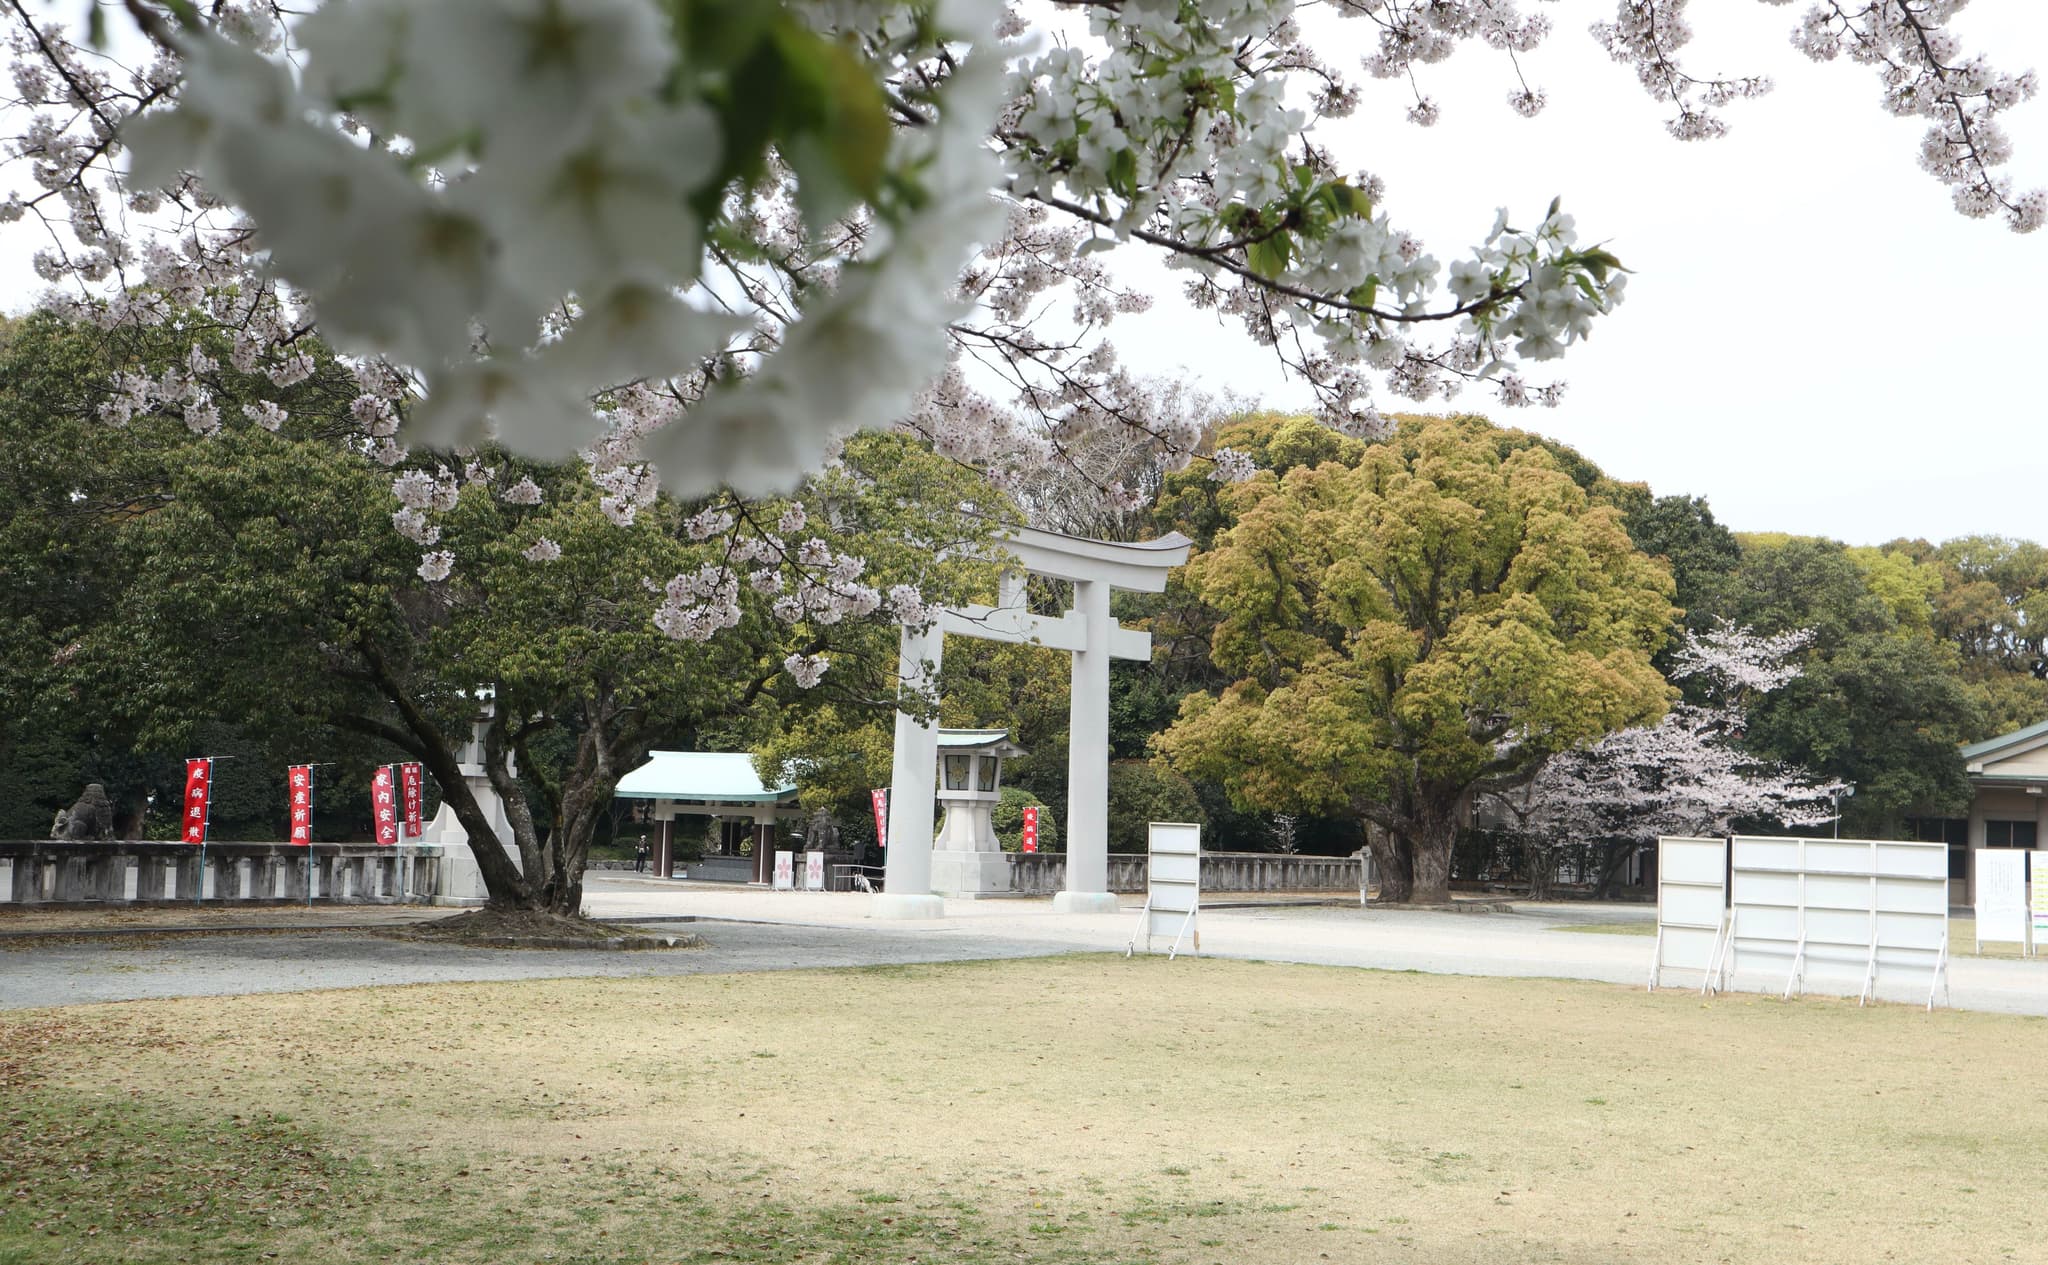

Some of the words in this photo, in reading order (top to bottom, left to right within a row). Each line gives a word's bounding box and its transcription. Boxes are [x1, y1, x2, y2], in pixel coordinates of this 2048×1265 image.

[189, 768, 205, 838] 疫病退散
[293, 774, 307, 838] 安産祈願
[376, 773, 394, 839] 家内安全
[1025, 813, 1034, 853] 疫病退
